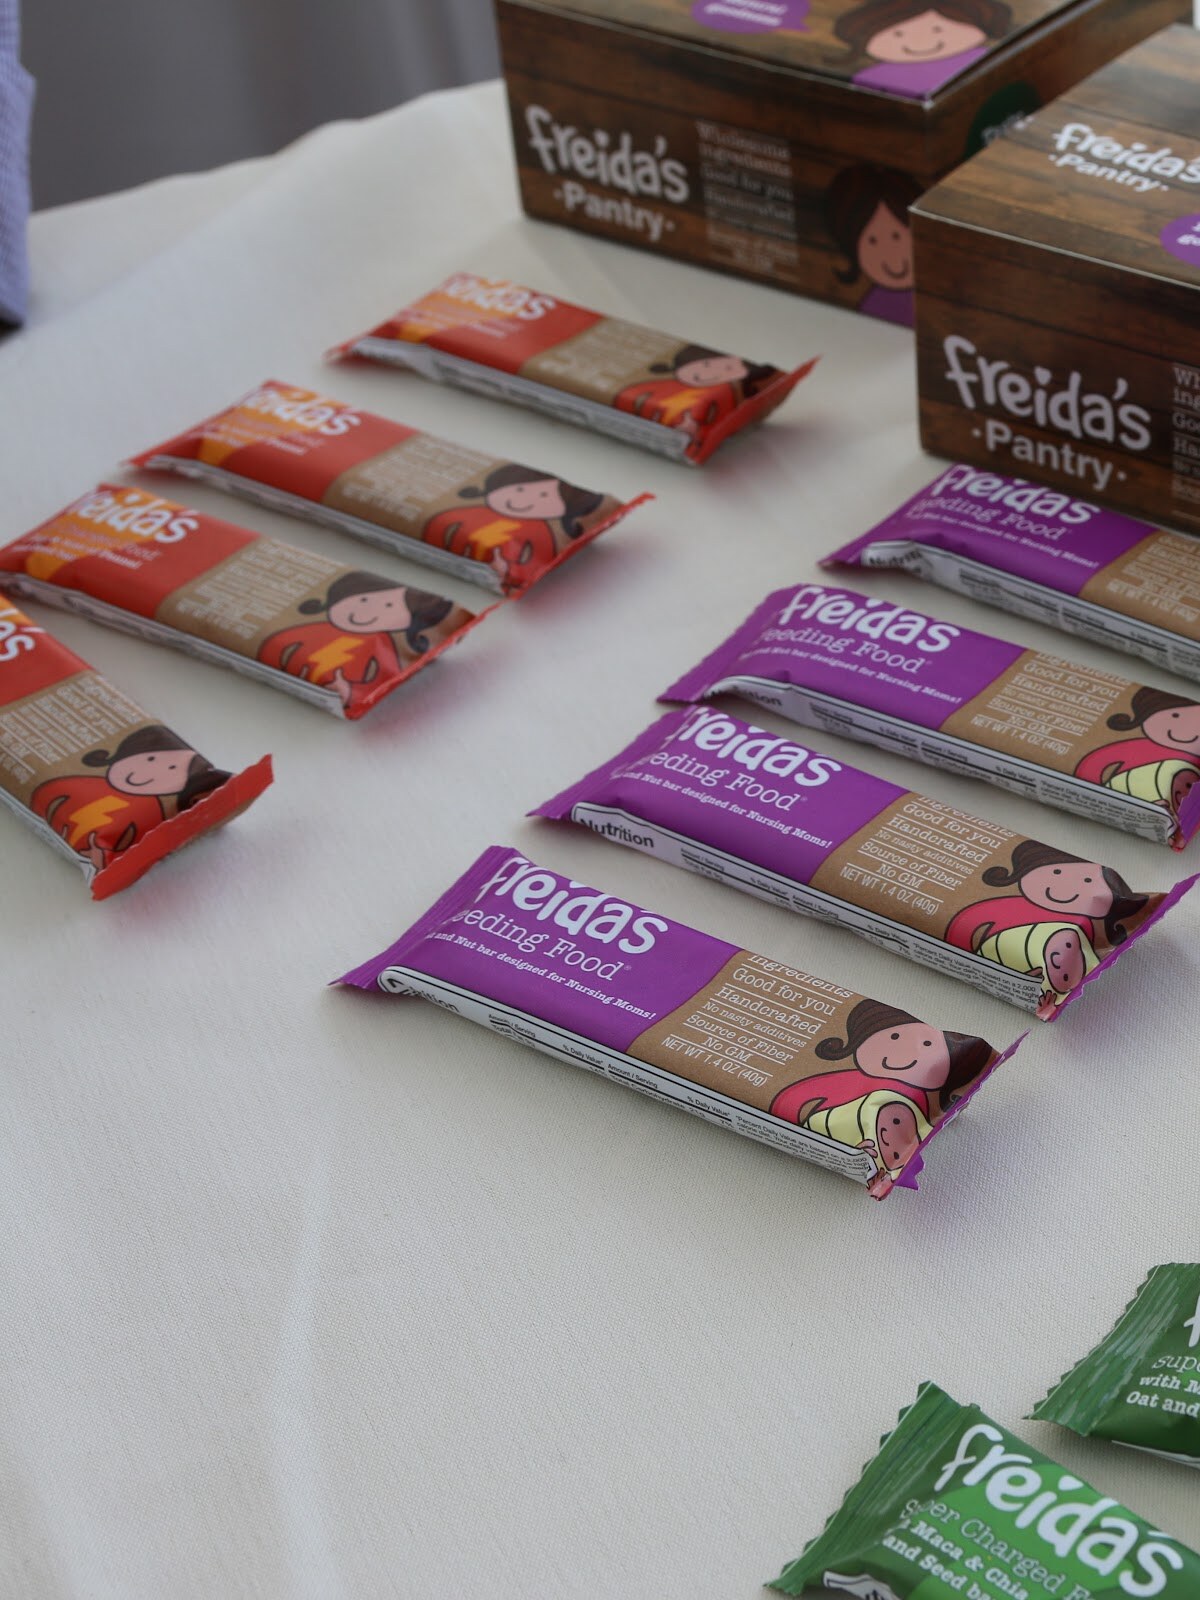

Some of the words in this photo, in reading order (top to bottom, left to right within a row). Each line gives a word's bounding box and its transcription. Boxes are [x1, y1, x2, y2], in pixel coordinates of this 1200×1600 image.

[526, 104, 690, 202] freida's
[943, 334, 1152, 450] freida's
[662, 779, 682, 792] bar
[681, 786, 731, 810] designed
[728, 801, 748, 816] for
[745, 811, 791, 836] Nursing
[789, 826, 833, 849] Moms!
[453, 936, 477, 950] Nut
[476, 943, 498, 958] bar
[496, 952, 554, 979] designed
[548, 970, 567, 985] for
[564, 980, 620, 1005] Nursing
[612, 997, 657, 1020] Moms!
[732, 967, 777, 993] Good
[775, 983, 803, 1002] for
[800, 996, 837, 1017] you
[748, 955, 854, 999] ingredients
[702, 1001, 720, 1014] No
[719, 1008, 752, 1028] nasty
[752, 1023, 808, 1049] additives
[714, 986, 822, 1035] Handcrafted
[661, 1036, 685, 1053] NET
[683, 1046, 706, 1060] WT
[703, 1053, 720, 1068] 1.4
[721, 1059, 741, 1075] OZ
[736, 1068, 769, 1088] (40g)
[686, 1014, 738, 1039] Source
[737, 1034, 757, 1047] of
[752, 1041, 794, 1062] Fiber
[702, 1036, 723, 1052] No
[724, 1045, 754, 1063] GM
[1125, 1390, 1159, 1409] Oat
[1161, 1397, 1200, 1419] and
[1138, 1373, 1182, 1395] with
[933, 1423, 1185, 1598] freida's
[882, 1534, 923, 1562] and
[918, 1553, 969, 1590] Seed
[909, 1519, 964, 1561] Maca
[964, 1554, 984, 1572] &
[960, 1517, 1066, 1594] Charged
